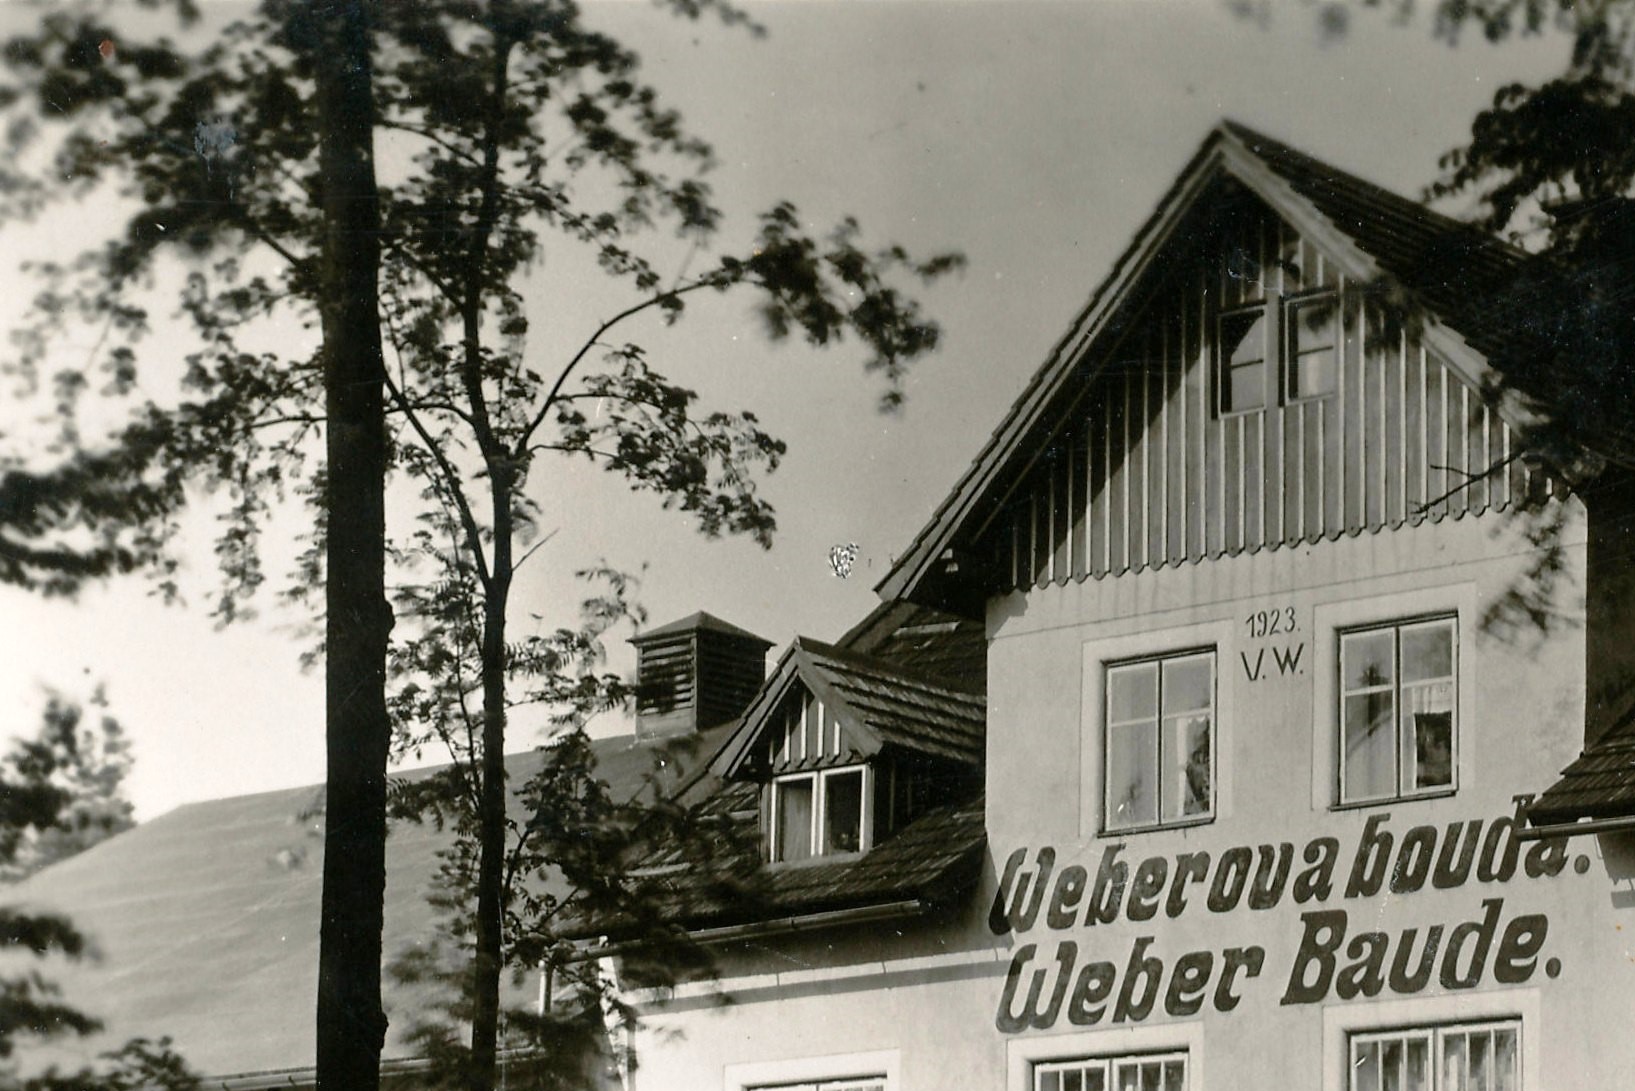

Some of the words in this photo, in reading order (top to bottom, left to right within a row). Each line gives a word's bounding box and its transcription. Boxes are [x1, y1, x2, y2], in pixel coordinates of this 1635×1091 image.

[989, 836, 1341, 935] Weberova
[996, 936, 1266, 1034] Weber
[1280, 898, 1562, 1006] Baude.
